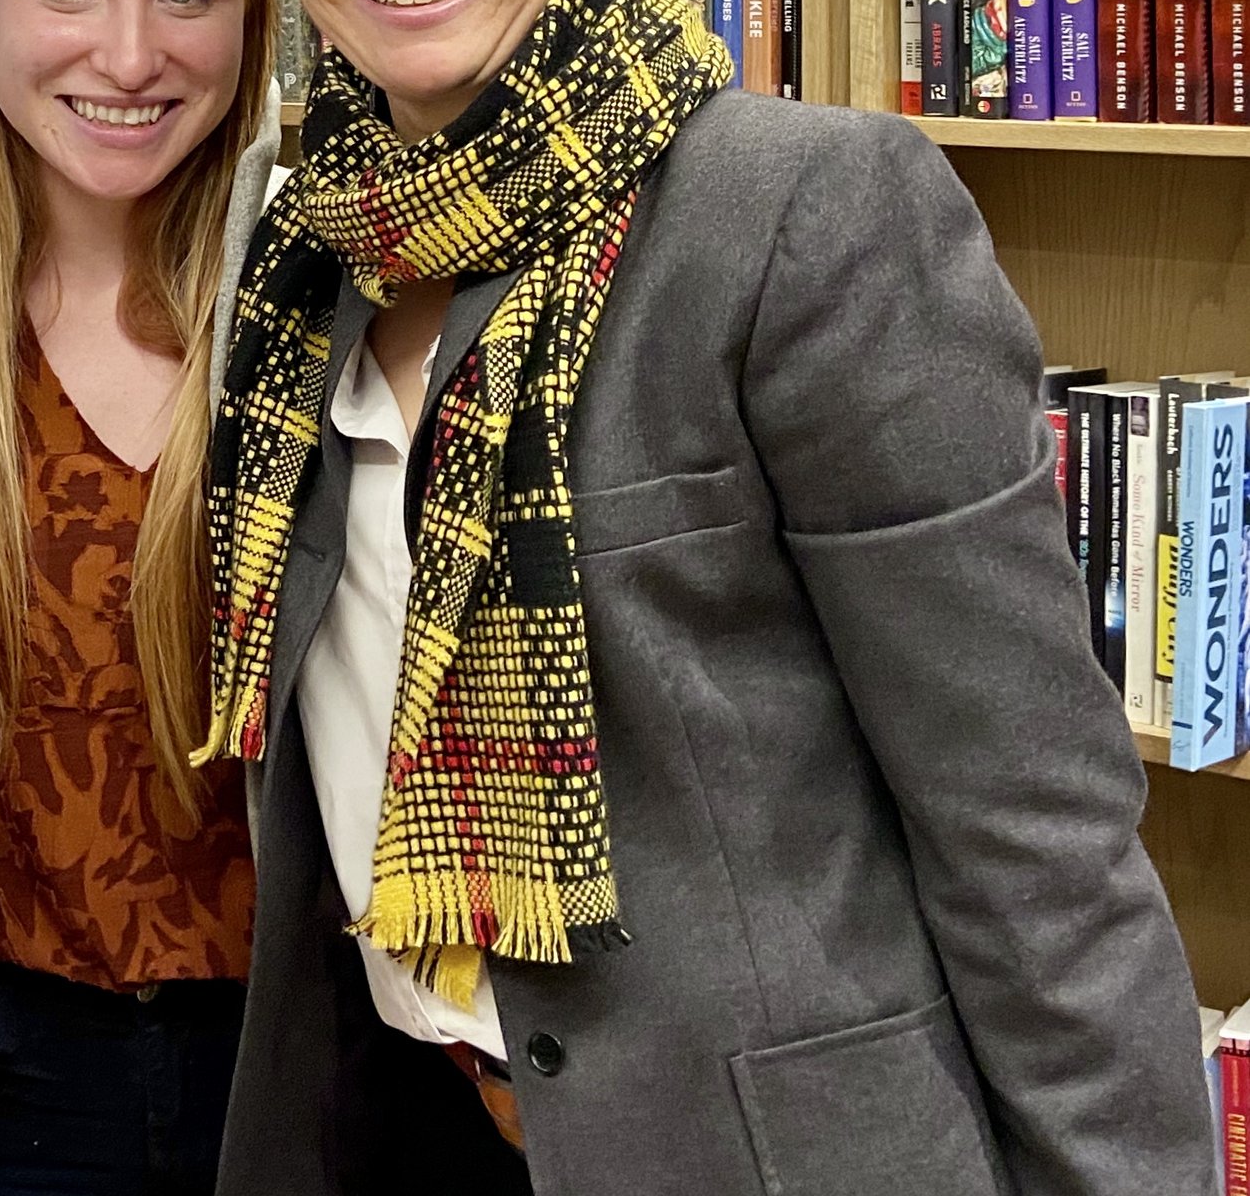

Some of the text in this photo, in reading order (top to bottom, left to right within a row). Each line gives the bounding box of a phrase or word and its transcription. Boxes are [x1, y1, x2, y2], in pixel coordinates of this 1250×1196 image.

[749, 0, 763, 38] KLEE
[932, 23, 942, 67] ABRAMS
[1014, 16, 1027, 83] AUSTERLITZ
[1028, 35, 1041, 64] SAUL
[1061, 12, 1075, 81] AUSTERLITZ
[1076, 33, 1089, 61] SAUL
[1116, 3, 1127, 110] MICHAEL BENSON
[1174, 3, 1185, 111] MICHAEL BENSON
[1232, 3, 1244, 112] MICHAEL BENSON
[1080, 412, 1090, 428] THE
[1166, 393, 1180, 455] Lauterbach
[1080, 429, 1090, 468] ULTIMATE
[1080, 469, 1090, 505] HISTORY
[1110, 412, 1121, 597] Where No Black Woman Has Gone Before
[1133, 473, 1146, 510] Some
[1080, 506, 1090, 518] OF
[1080, 518, 1090, 535] THE
[1132, 514, 1145, 547] Kind
[1179, 521, 1195, 597] WONDERS
[1130, 565, 1144, 612] Mirror
[1203, 422, 1234, 747] WONDERS
[1227, 1113, 1247, 1181] CINEMATIC
